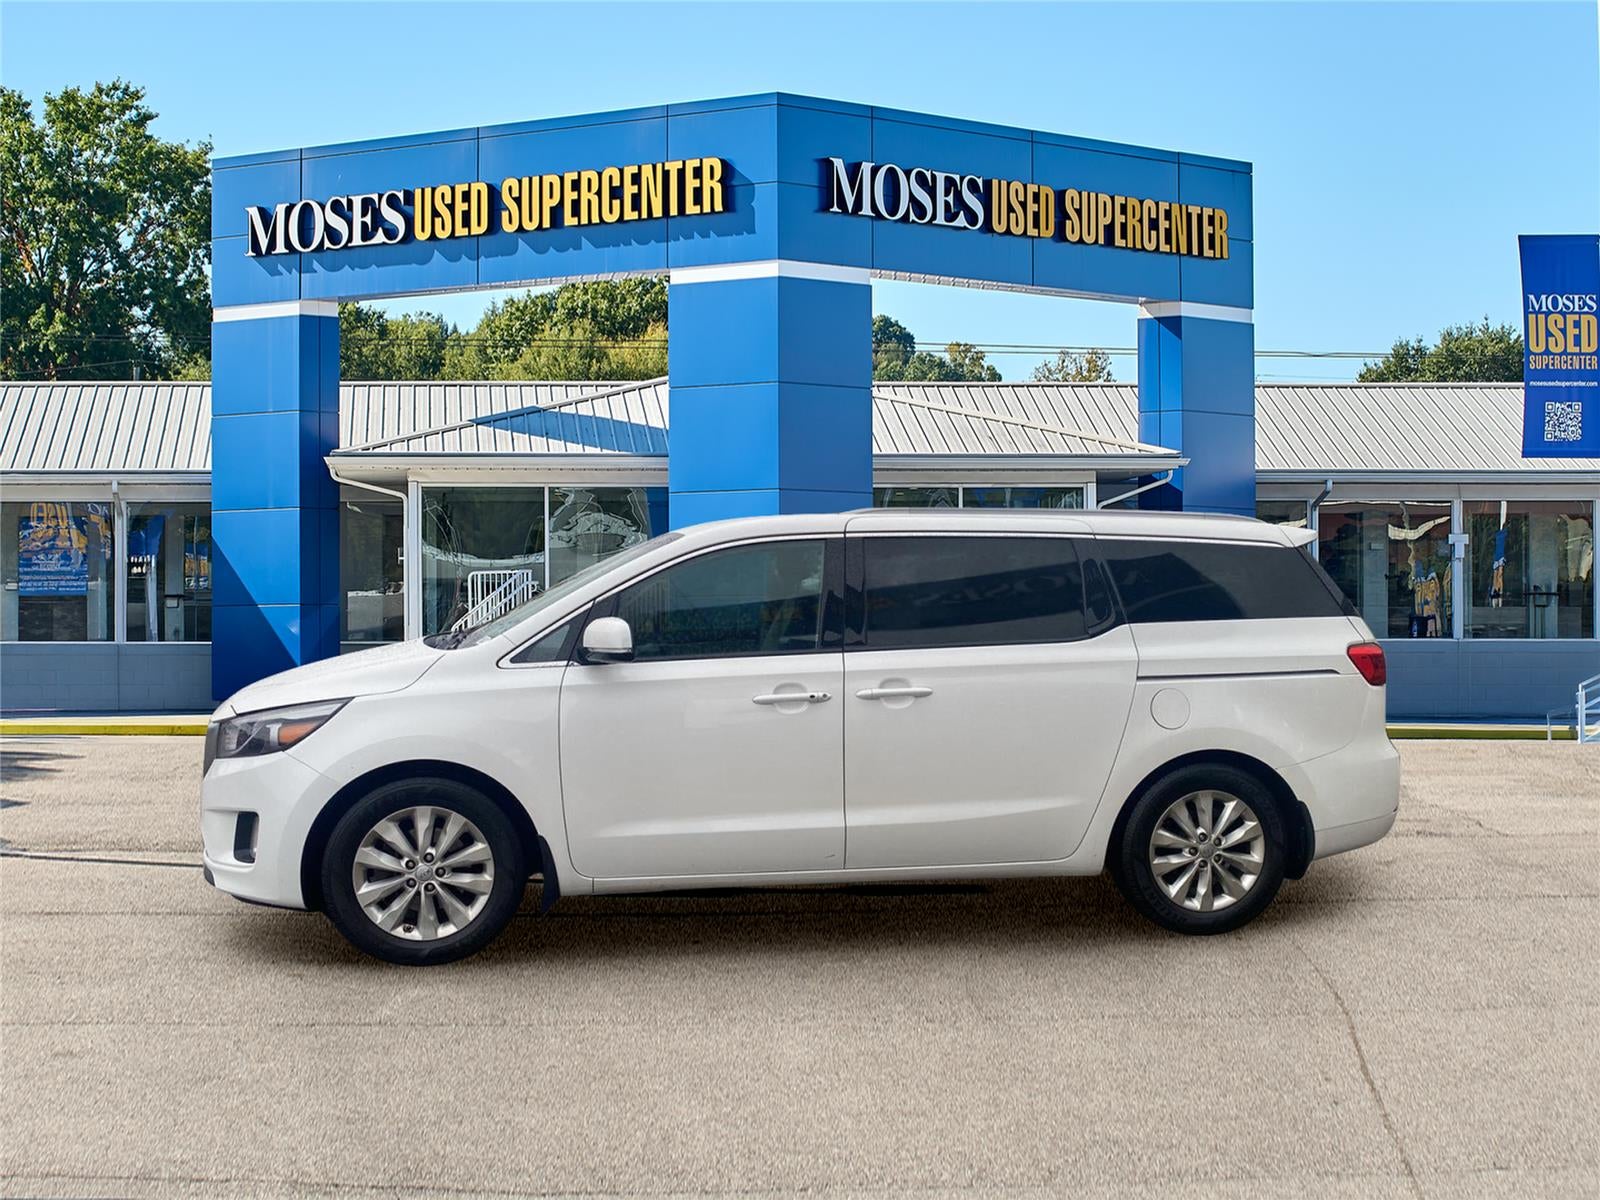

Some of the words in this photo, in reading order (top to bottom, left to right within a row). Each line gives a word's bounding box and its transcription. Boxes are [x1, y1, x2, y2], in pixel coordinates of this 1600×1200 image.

[245, 189, 406, 257] MOSES
[413, 181, 488, 241] USED
[501, 156, 724, 233] SUPERCENTER
[828, 157, 985, 230] MOSES
[991, 178, 1055, 239] USED
[1065, 188, 1229, 260] SUPERCENTER
[1527, 294, 1598, 313] MOSES
[1528, 314, 1598, 353] USED
[1529, 355, 1598, 370] SUPERCENTER
